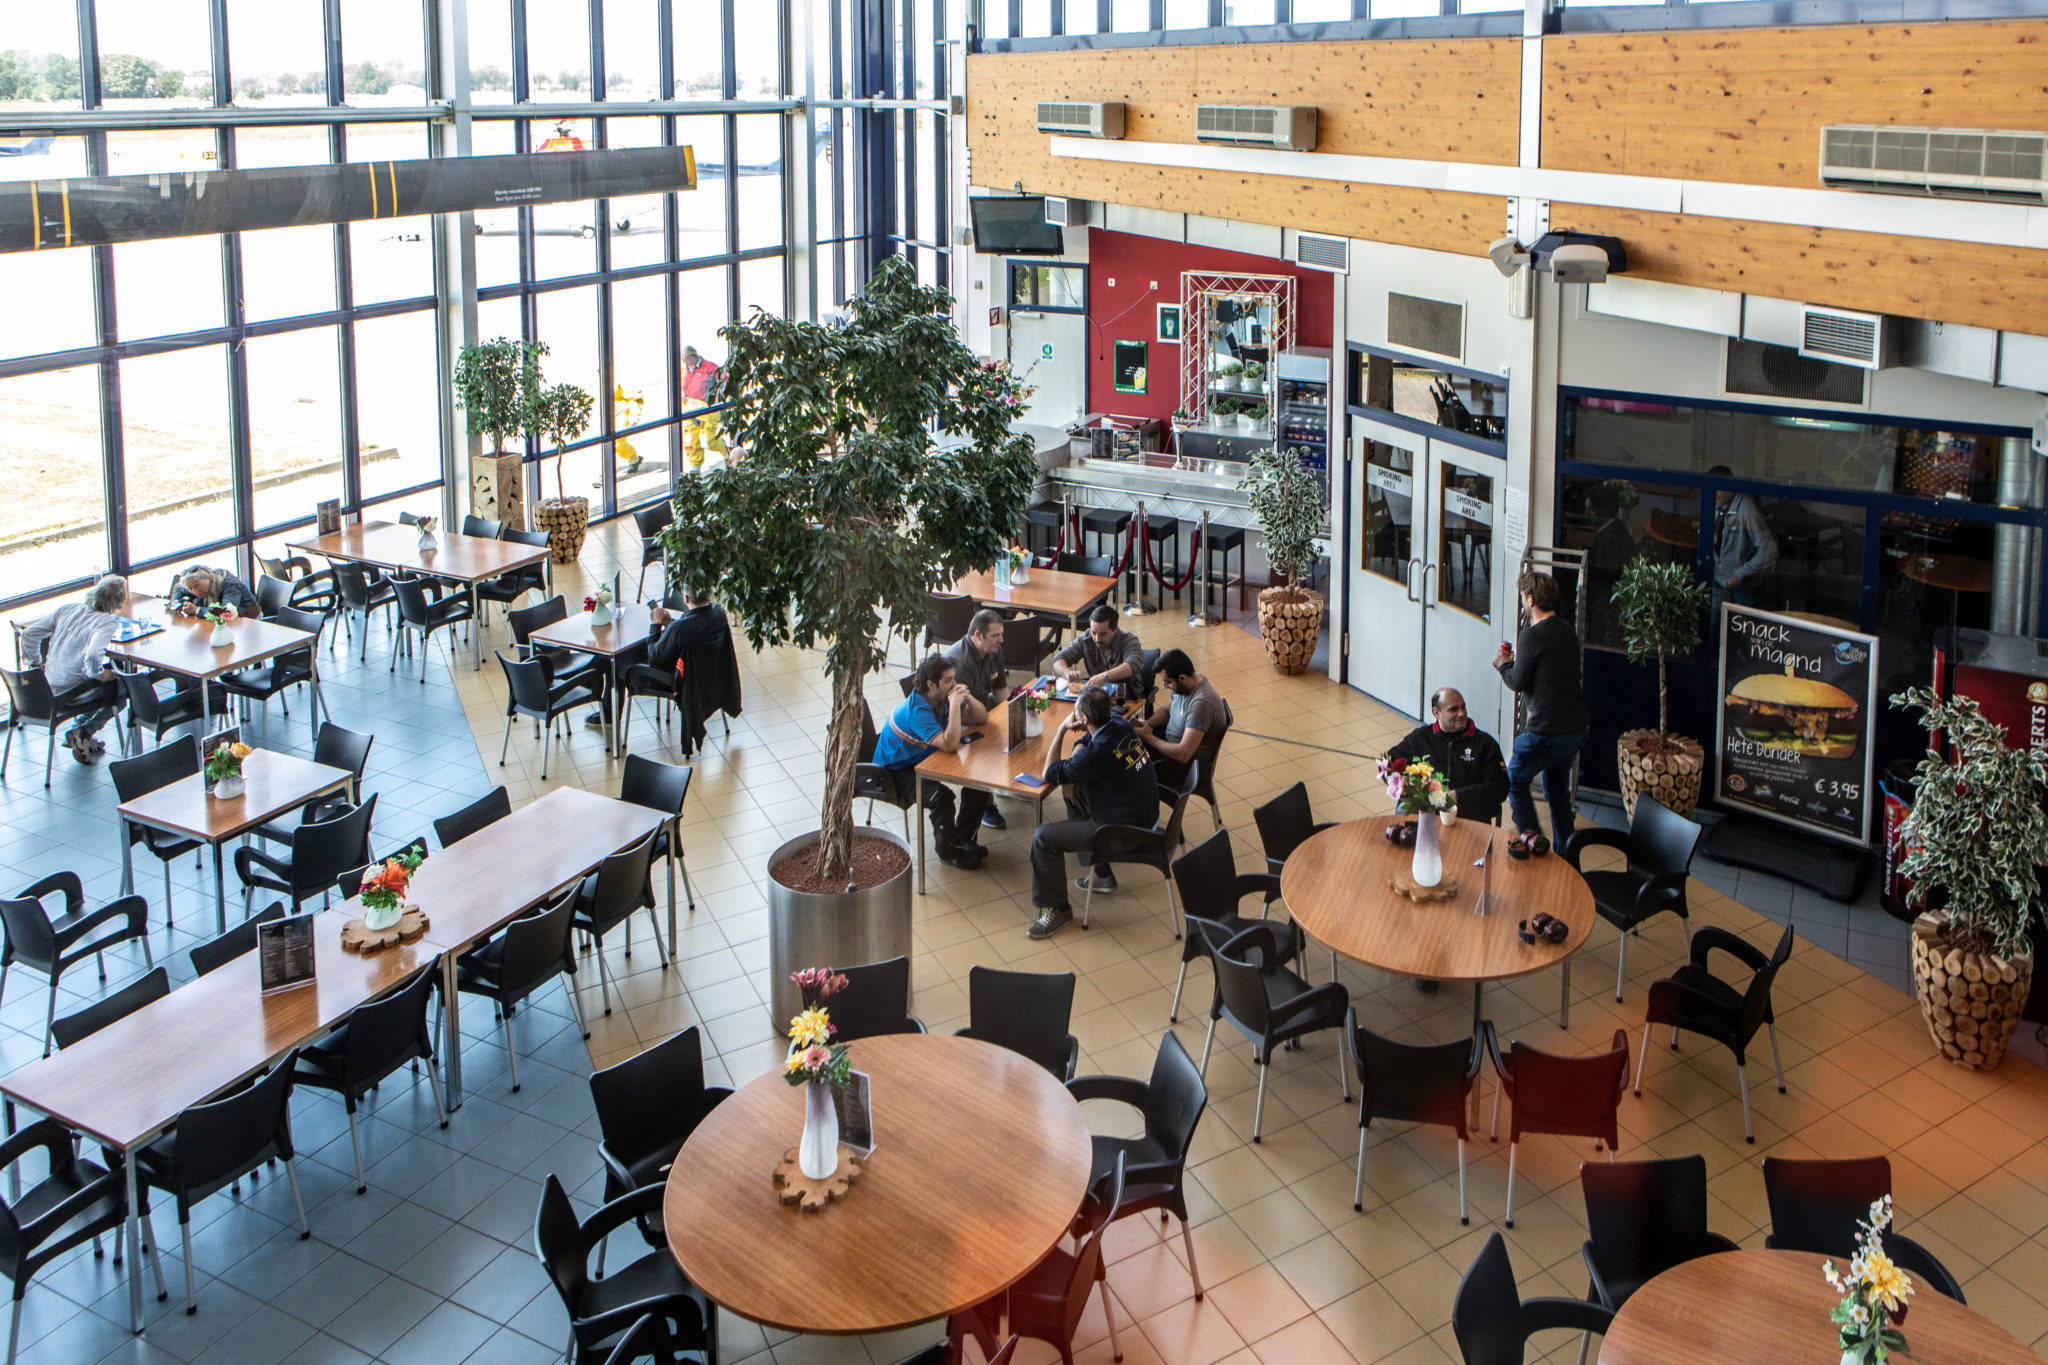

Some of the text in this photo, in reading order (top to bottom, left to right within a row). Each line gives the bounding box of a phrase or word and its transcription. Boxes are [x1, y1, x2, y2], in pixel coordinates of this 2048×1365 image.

[1378, 468, 1402, 483] SMOKING
[1383, 480, 1396, 490] AREA
[1456, 494, 1482, 510] SMOKING
[1462, 506, 1476, 518] AREA
[1731, 615, 1790, 642] Snack
[1750, 644, 1821, 673] maand
[1727, 736, 1753, 756] Hete
[1828, 780, 1860, 800] 3,95
